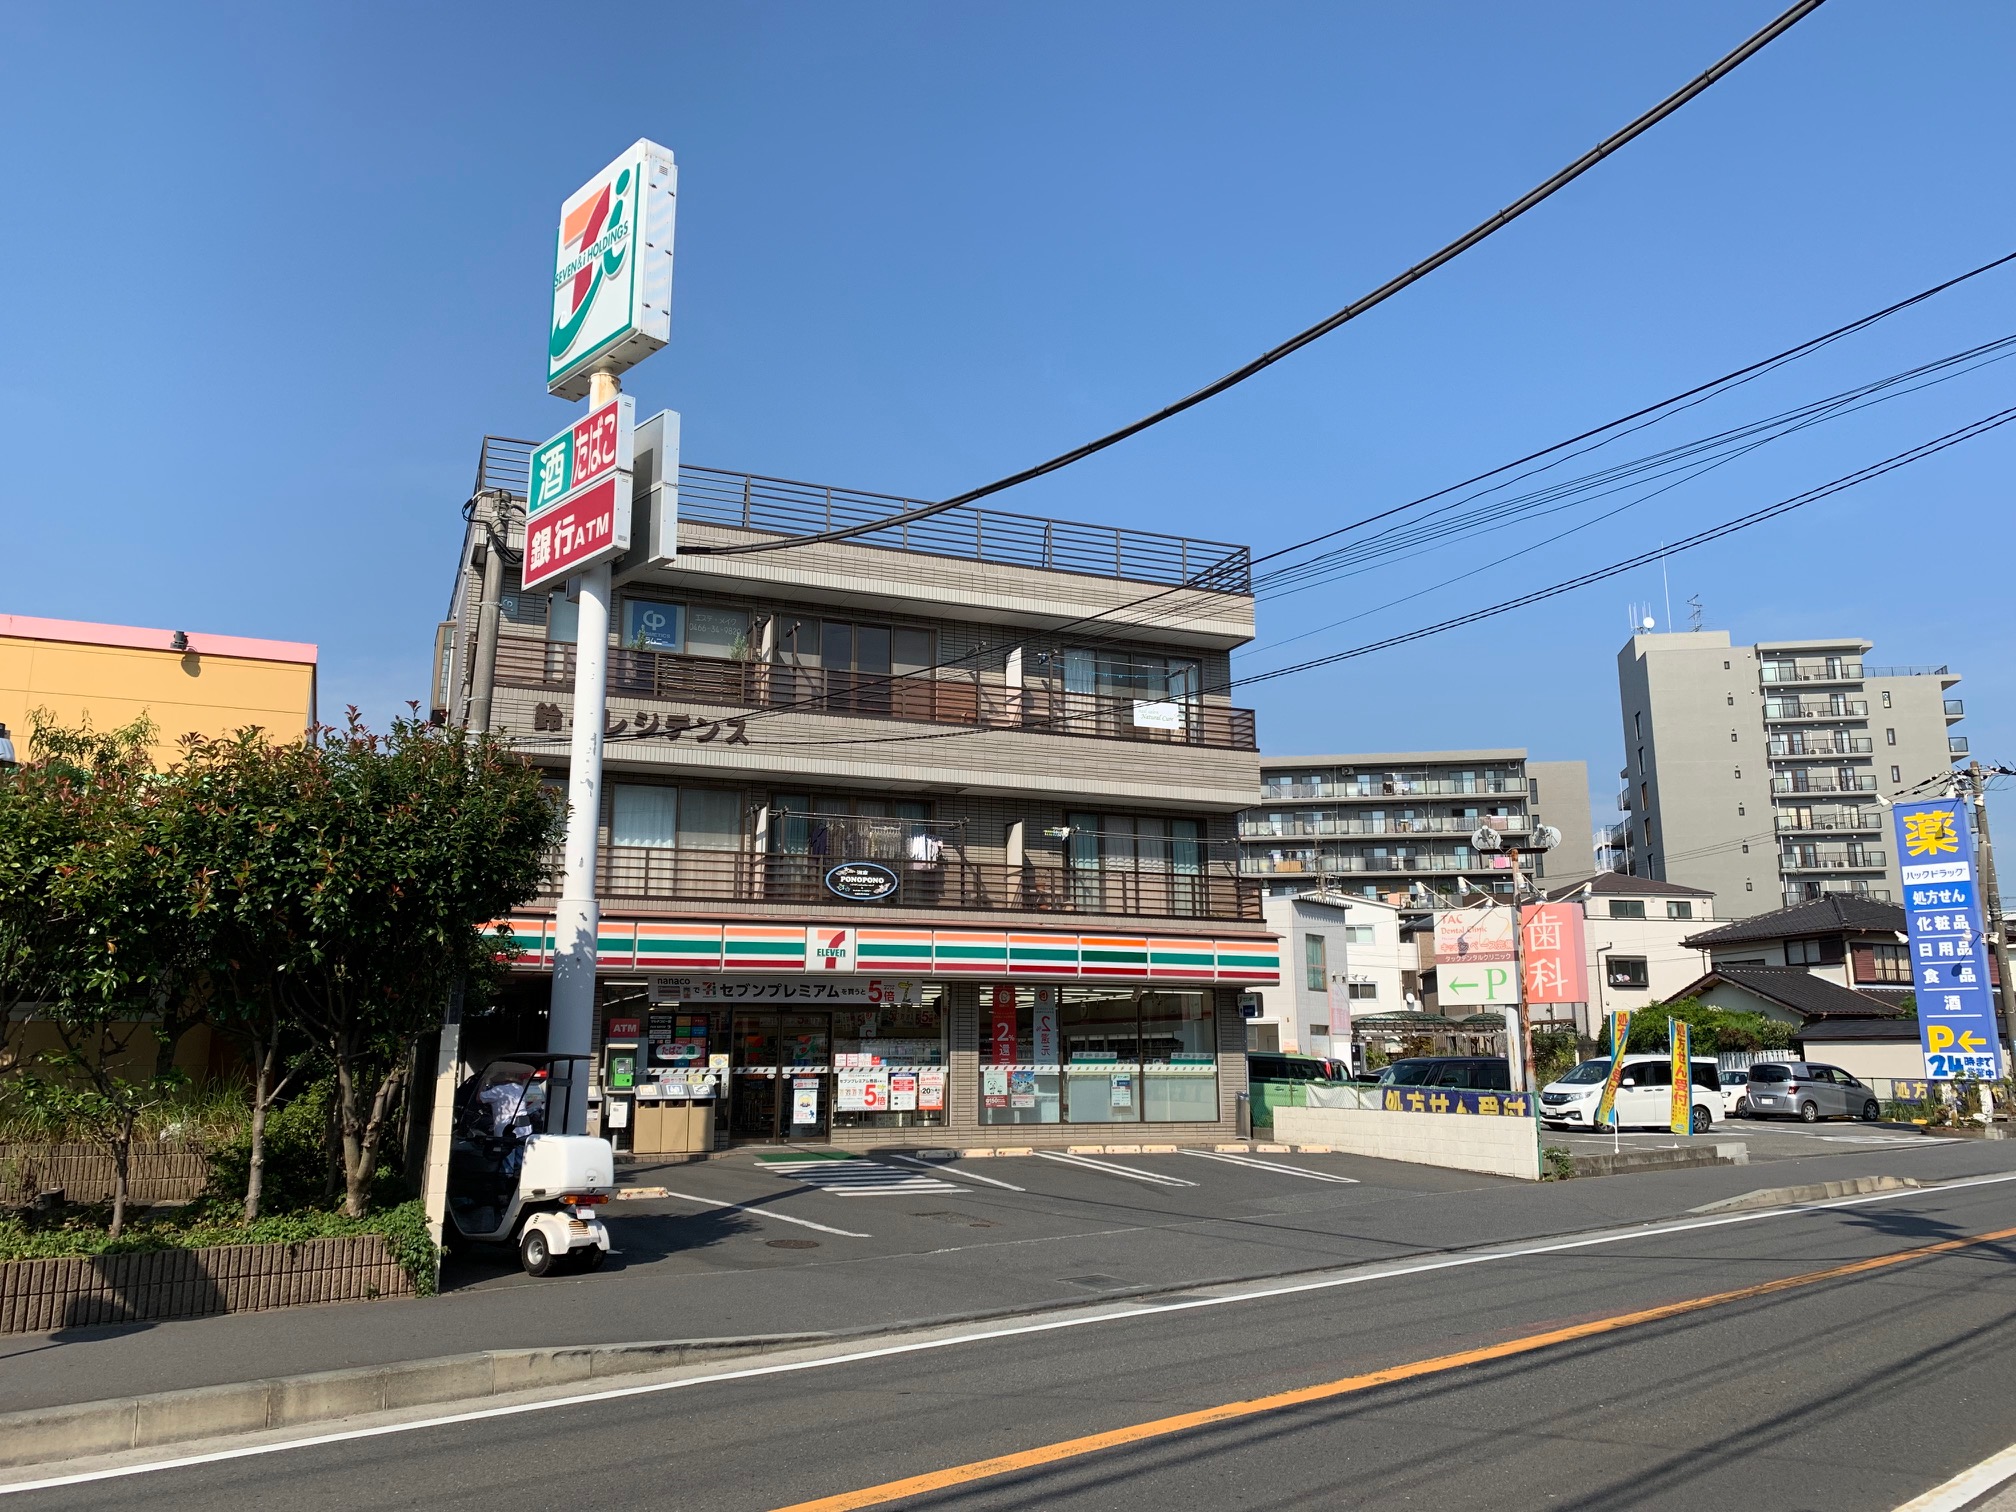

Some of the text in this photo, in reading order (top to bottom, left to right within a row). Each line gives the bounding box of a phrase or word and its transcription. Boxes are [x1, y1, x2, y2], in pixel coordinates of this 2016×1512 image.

[587, 220, 629, 262] HOLDINGS
[574, 412, 616, 484] たばこ
[537, 441, 566, 506] 酒
[534, 702, 750, 745] 鈴レジデンス
[1903, 810, 1959, 857] 薬
[840, 876, 885, 884] PONOPONO
[1912, 888, 1966, 906] 処方せん
[1441, 913, 1463, 924] TAC
[1916, 914, 1970, 932] 化粧品
[1441, 925, 1488, 935] Dental Clinic
[1445, 953, 1511, 963] タックデンタルクリニック
[1526, 911, 1569, 998] 歯科
[1918, 940, 1973, 958] 日用品
[657, 977, 690, 985] nanaco
[1484, 968, 1507, 1000] P
[1923, 967, 1977, 984] 食品
[1943, 995, 1962, 1011] 酒
[613, 1024, 637, 1033] ATM
[1926, 1025, 1955, 1053] P
[661, 1045, 682, 1055] たばこ
[1673, 1023, 1689, 1107] 処方せん受付
[1927, 1054, 1964, 1077] 24
[864, 1084, 877, 1107] 5
